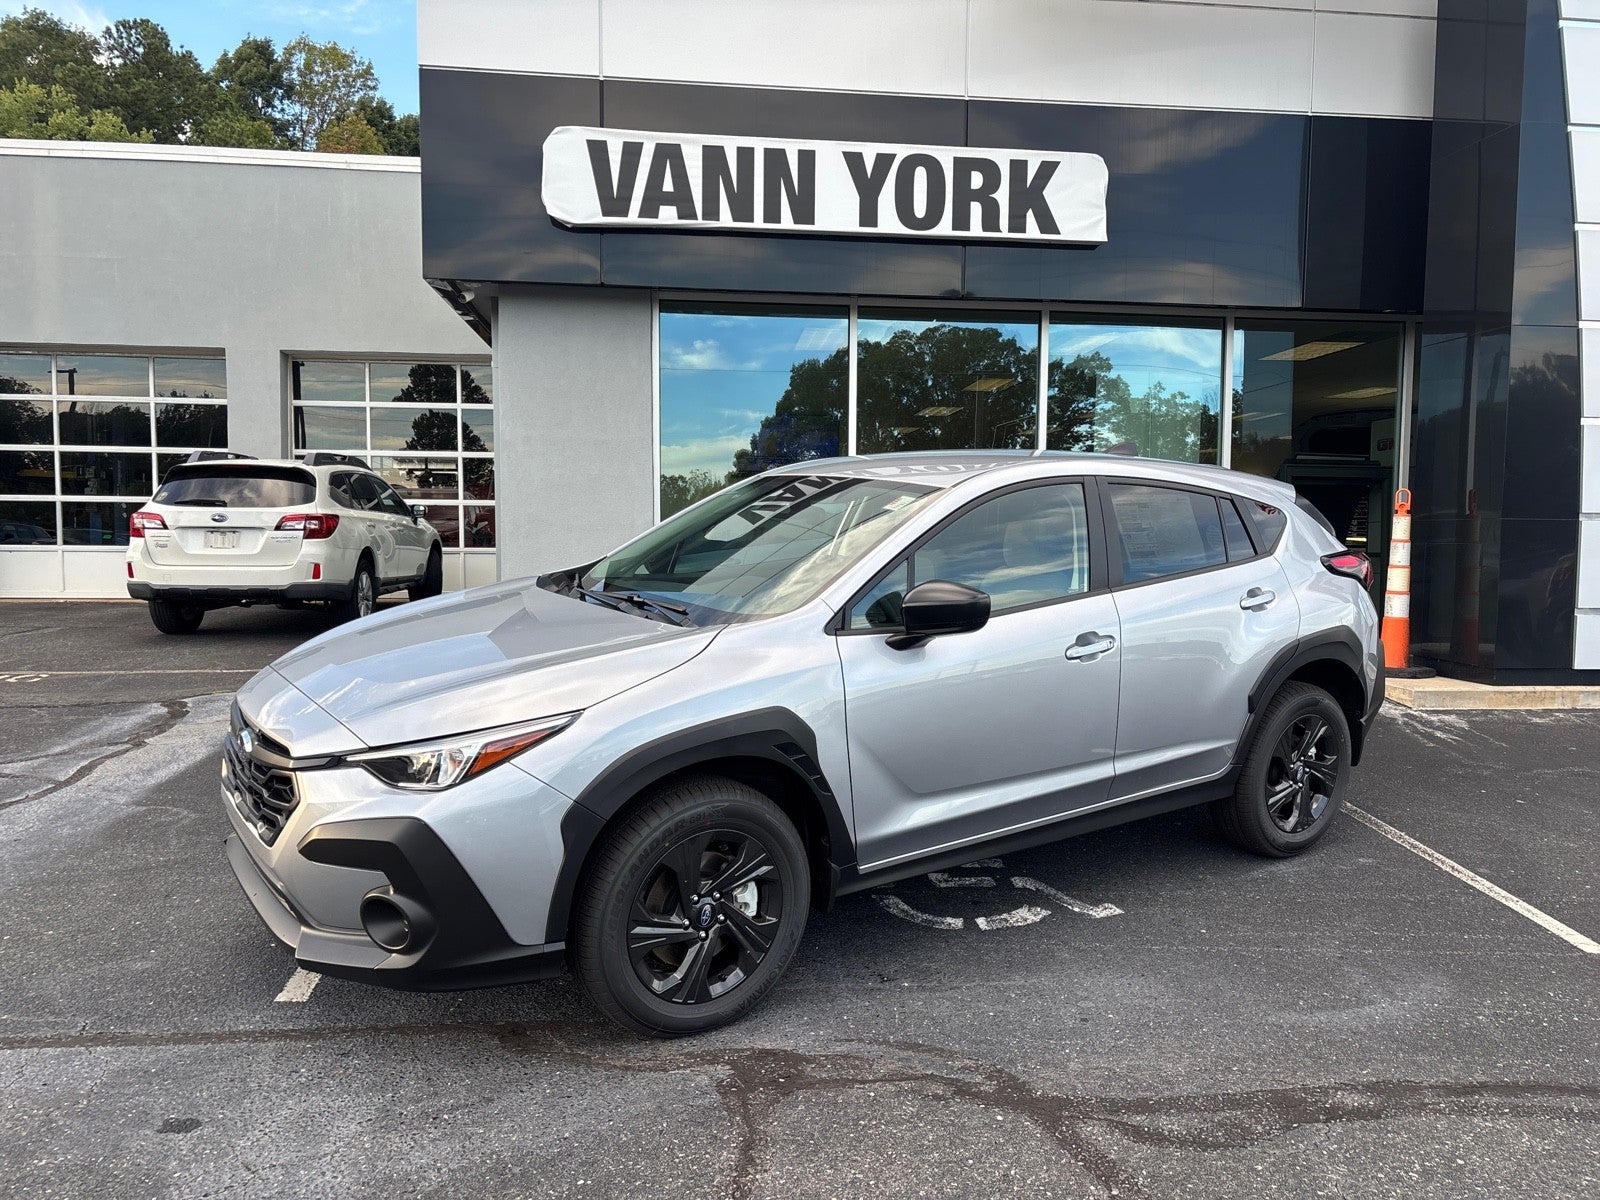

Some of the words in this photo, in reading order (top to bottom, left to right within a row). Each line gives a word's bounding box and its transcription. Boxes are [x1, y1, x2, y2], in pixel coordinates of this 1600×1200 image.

[586, 139, 816, 226] VANN
[842, 151, 1061, 235] YORK
[738, 948, 792, 1011] YOKOHAMA
